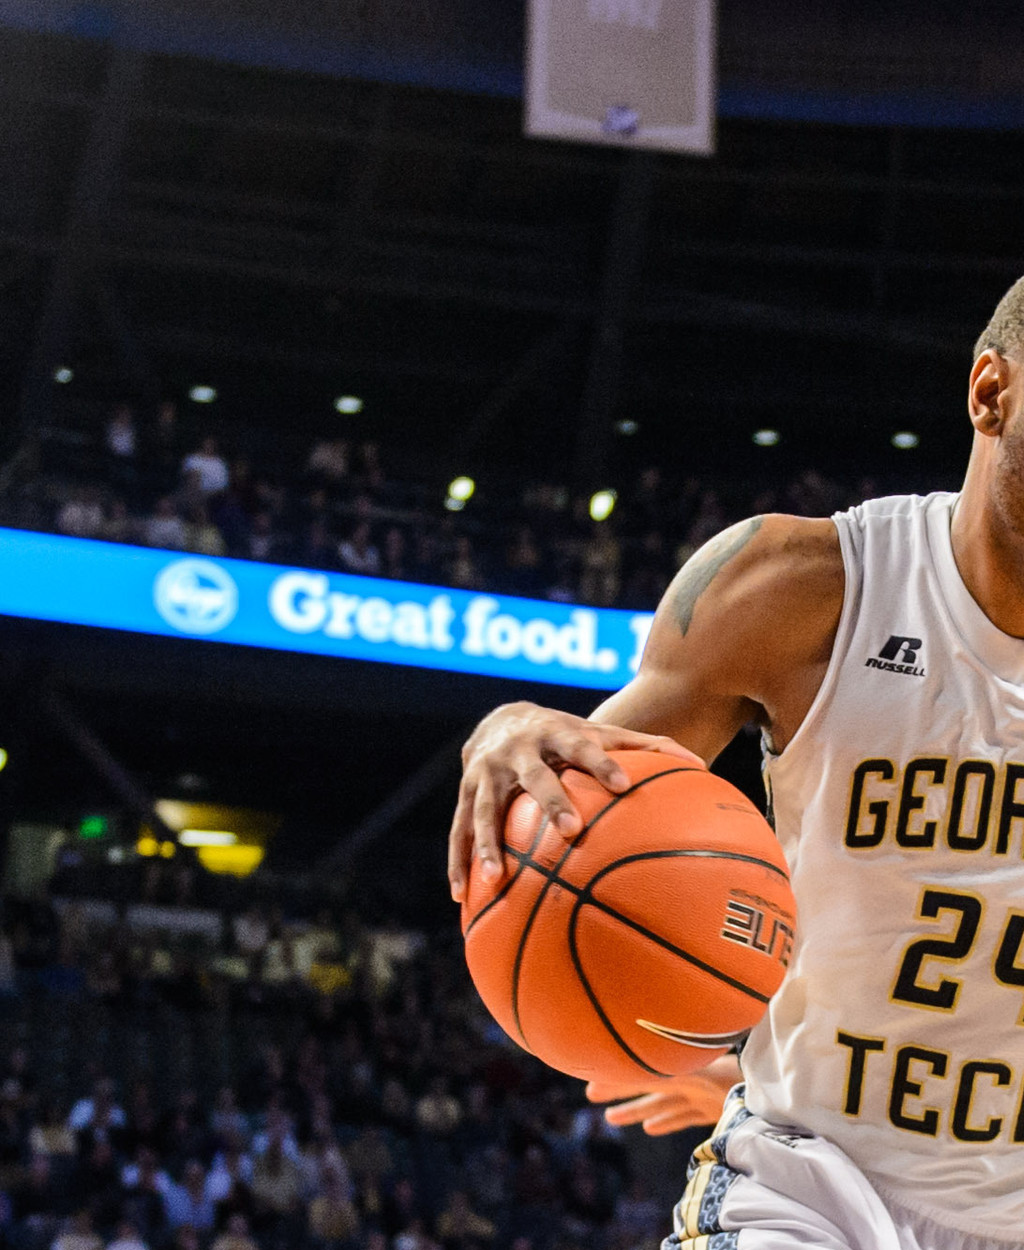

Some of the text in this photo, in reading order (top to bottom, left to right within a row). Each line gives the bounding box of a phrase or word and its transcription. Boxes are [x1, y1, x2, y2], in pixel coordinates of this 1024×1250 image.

[268, 572, 455, 650] Great
[461, 596, 617, 672] food.
[865, 657, 926, 677] RUSSELL
